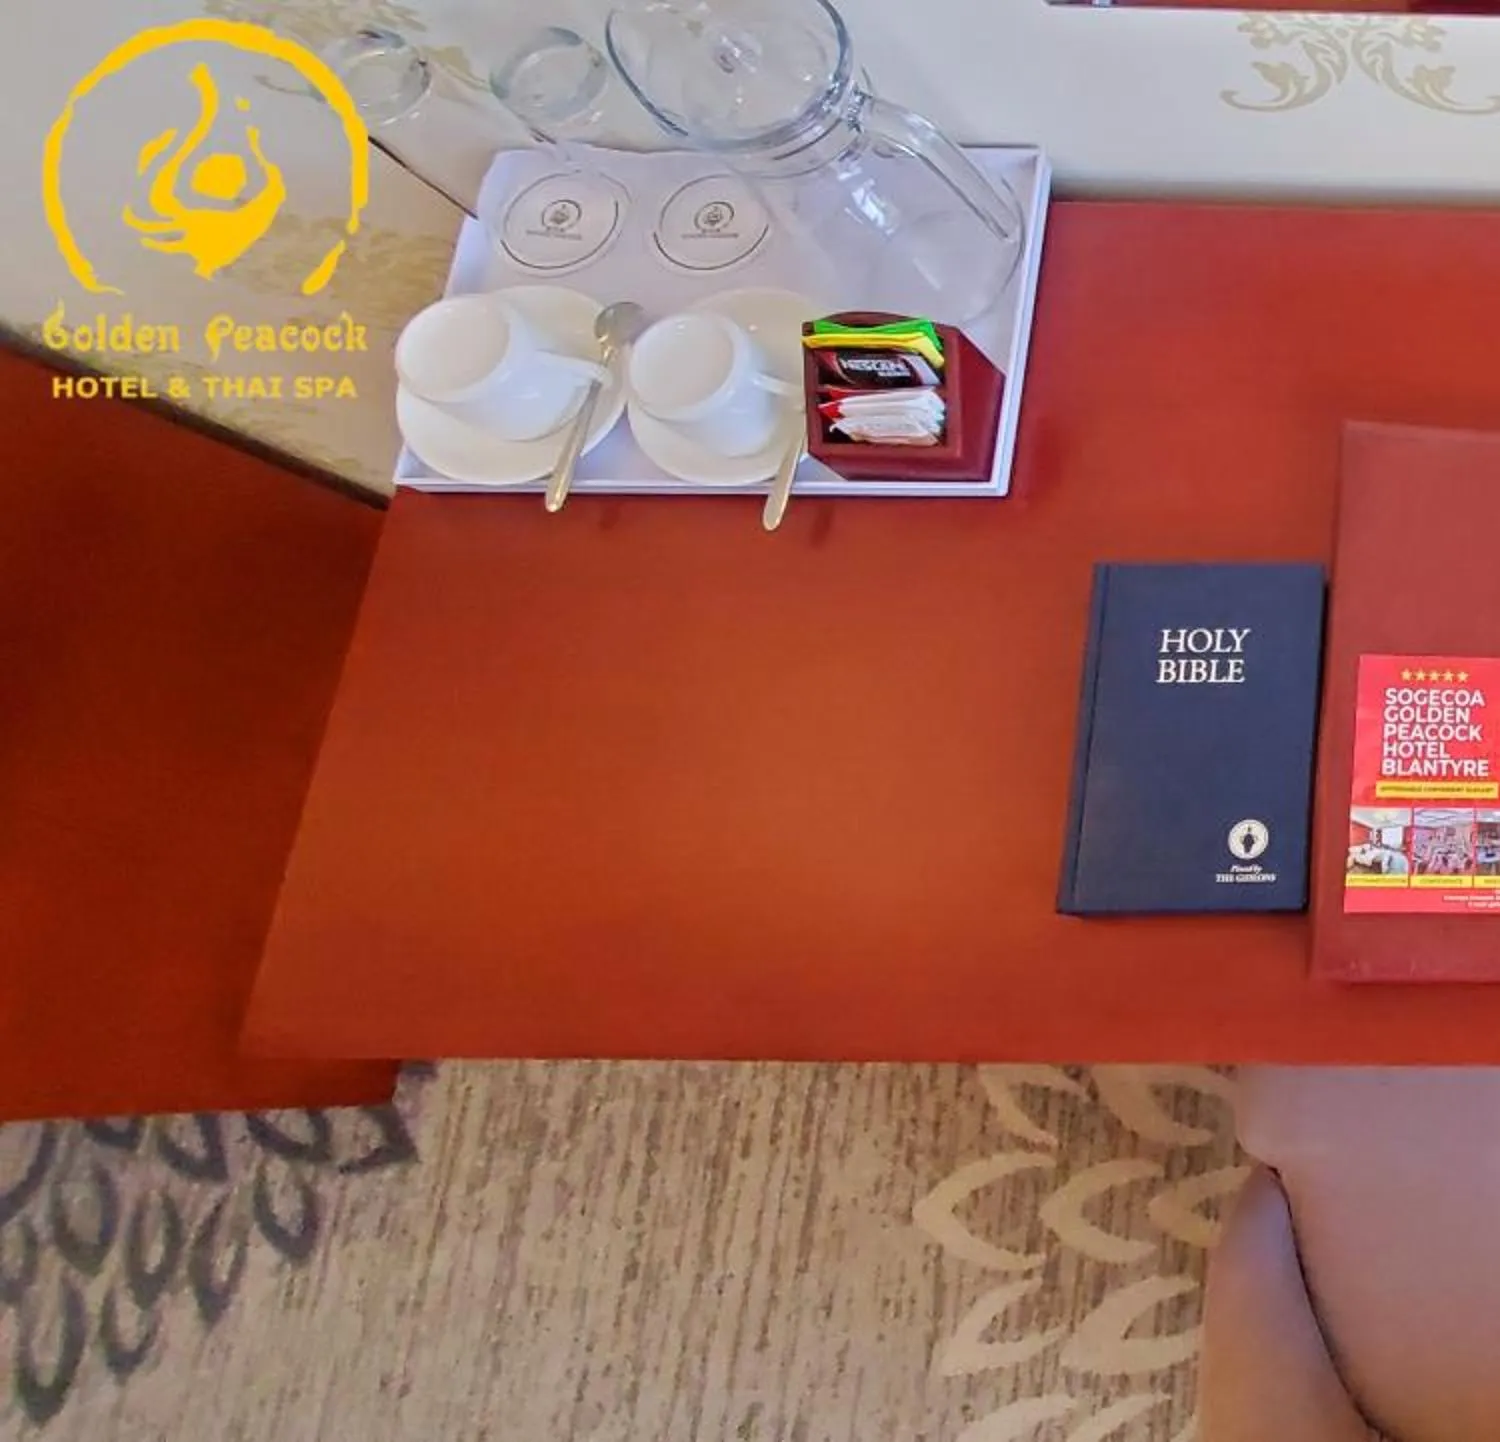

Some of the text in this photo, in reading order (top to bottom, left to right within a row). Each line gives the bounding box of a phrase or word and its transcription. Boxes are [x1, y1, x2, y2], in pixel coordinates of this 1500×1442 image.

[1159, 627, 1252, 653] HOLY
[1156, 659, 1246, 684] BIBLE
[1385, 687, 1486, 707] SOGECOA
[1383, 705, 1470, 723] GOLDEN
[1383, 723, 1483, 742] PEACOCK
[1383, 741, 1451, 759] HOTEL
[1381, 758, 1489, 777] BLANTYRE
